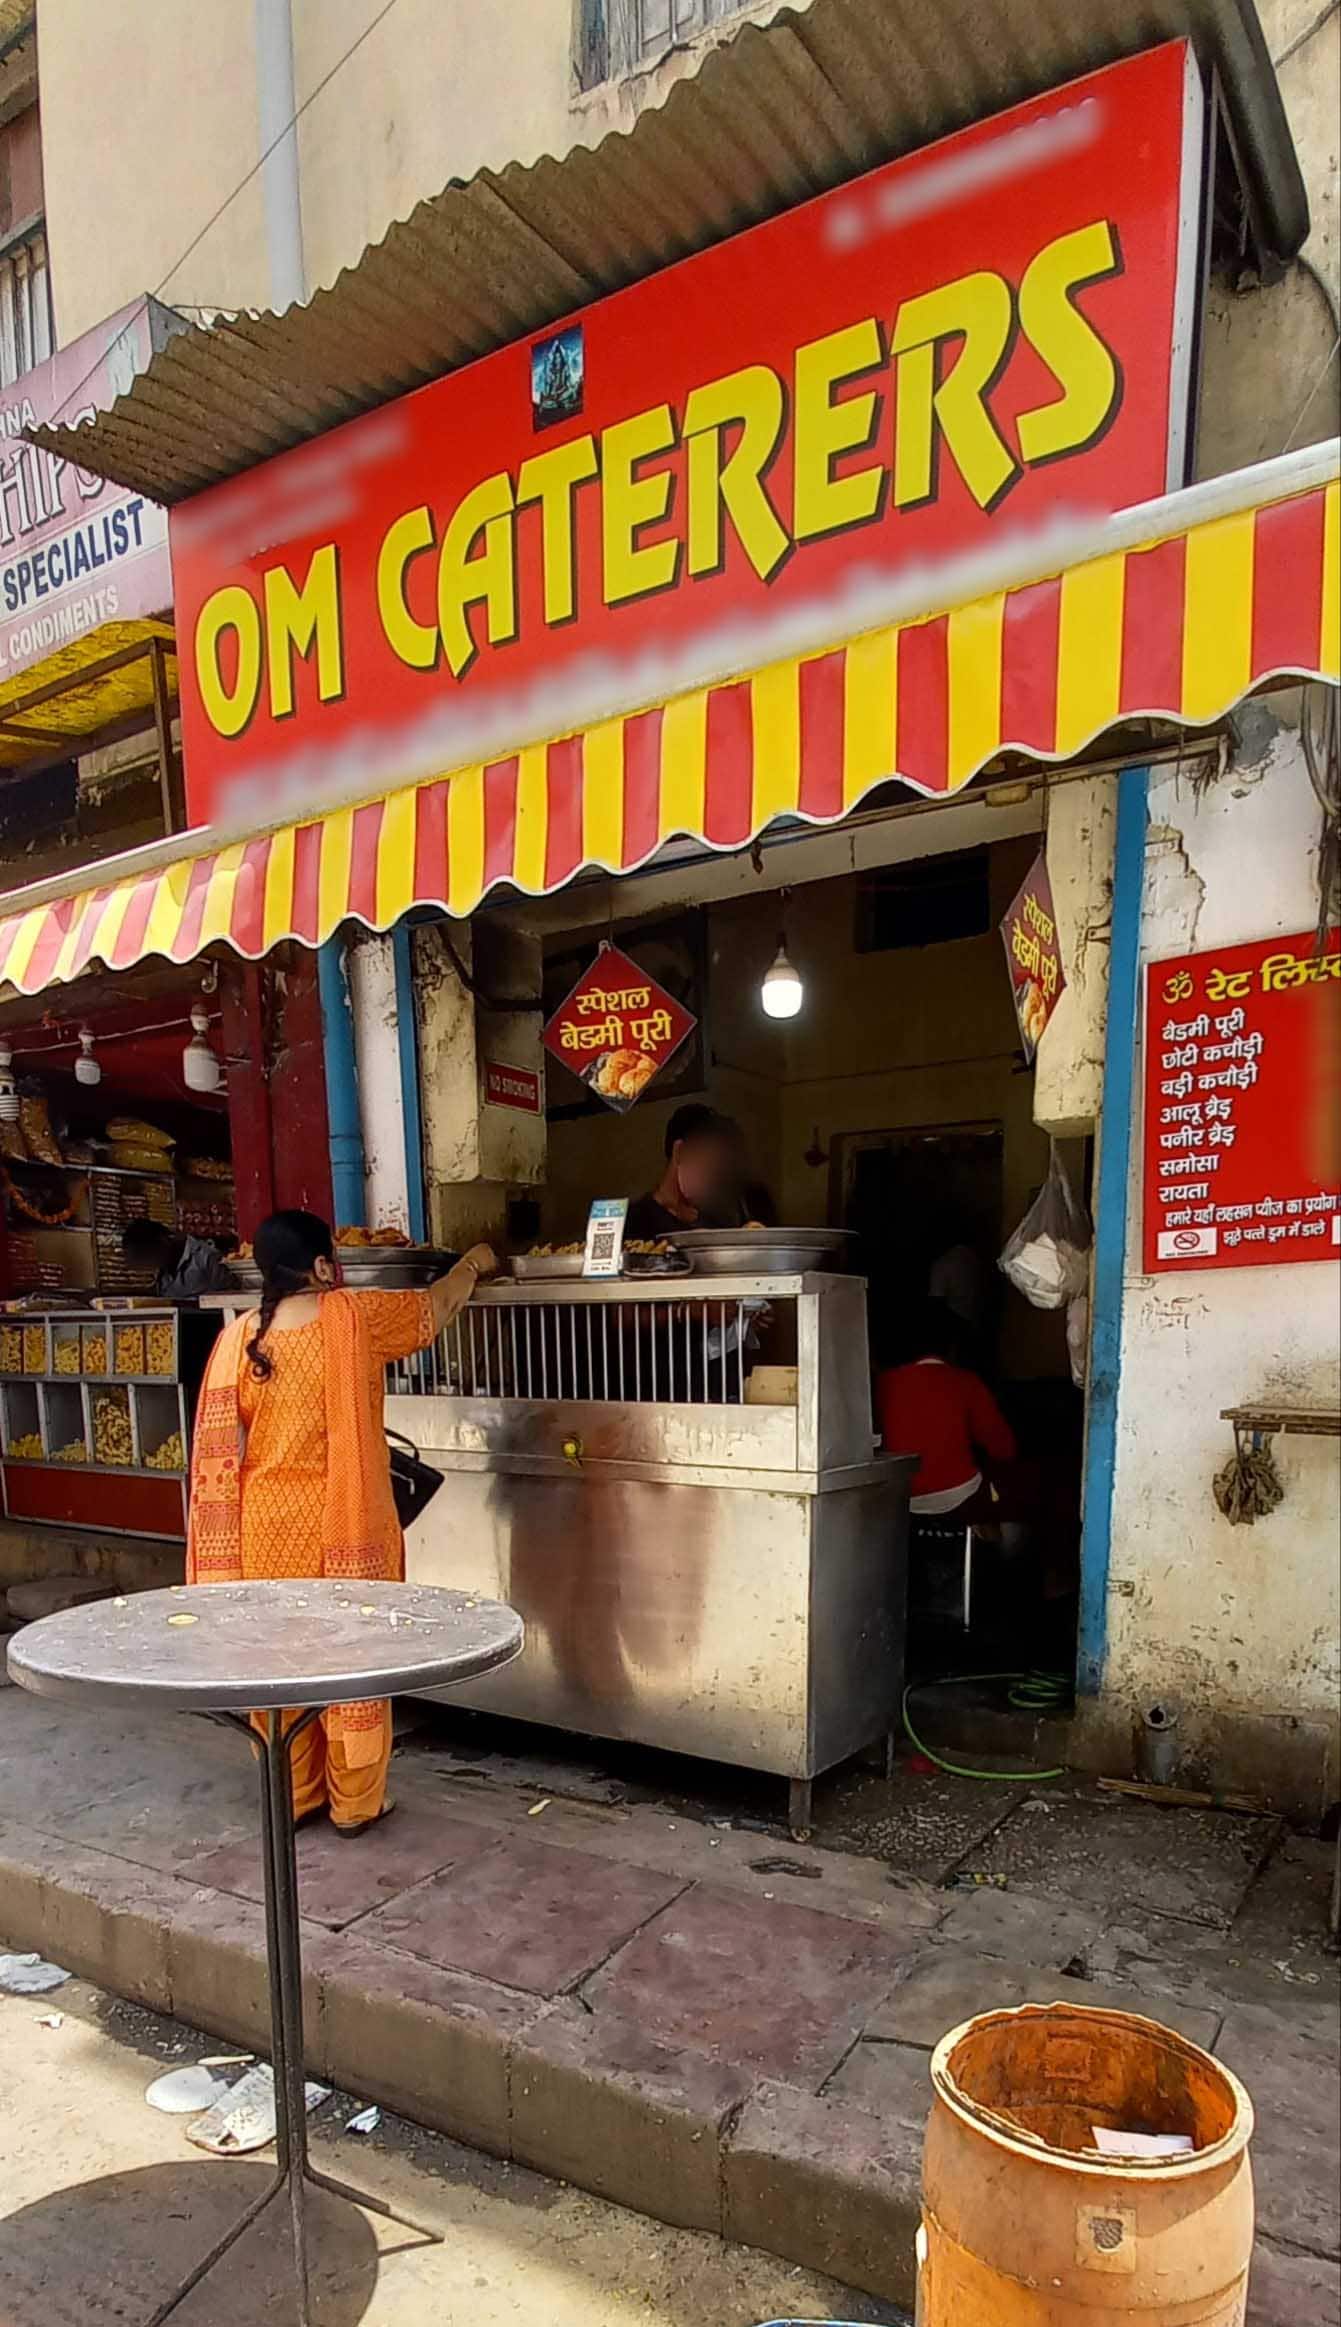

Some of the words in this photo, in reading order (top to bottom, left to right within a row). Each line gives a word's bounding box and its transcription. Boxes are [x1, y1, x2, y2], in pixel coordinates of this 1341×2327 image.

[195, 542, 345, 739] OM
[376, 219, 1121, 680] CATERERS
[3, 498, 144, 611] SPECIALIST
[9, 584, 119, 660] CONDIMENTS
[1022, 893, 1055, 945] स्पेशल
[1040, 953, 1057, 1000] पूरी
[1205, 968, 1253, 1001] रेट
[576, 986, 652, 1015] स्पेशल
[560, 1014, 624, 1050] बेडमी
[629, 1008, 672, 1051] पूरी
[1215, 1008, 1245, 1038] पूरी
[1162, 1043, 1199, 1069] छोटी
[1160, 1102, 1203, 1125] आलू
[1160, 1125, 1205, 1149] पनीर
[1159, 1152, 1219, 1176] समोसा
[1159, 1182, 1209, 1203] रायता
[1165, 1205, 1192, 1228] हमारे
[1286, 1199, 1303, 1214] का
[1305, 1191, 1337, 1216] प्रयोग
